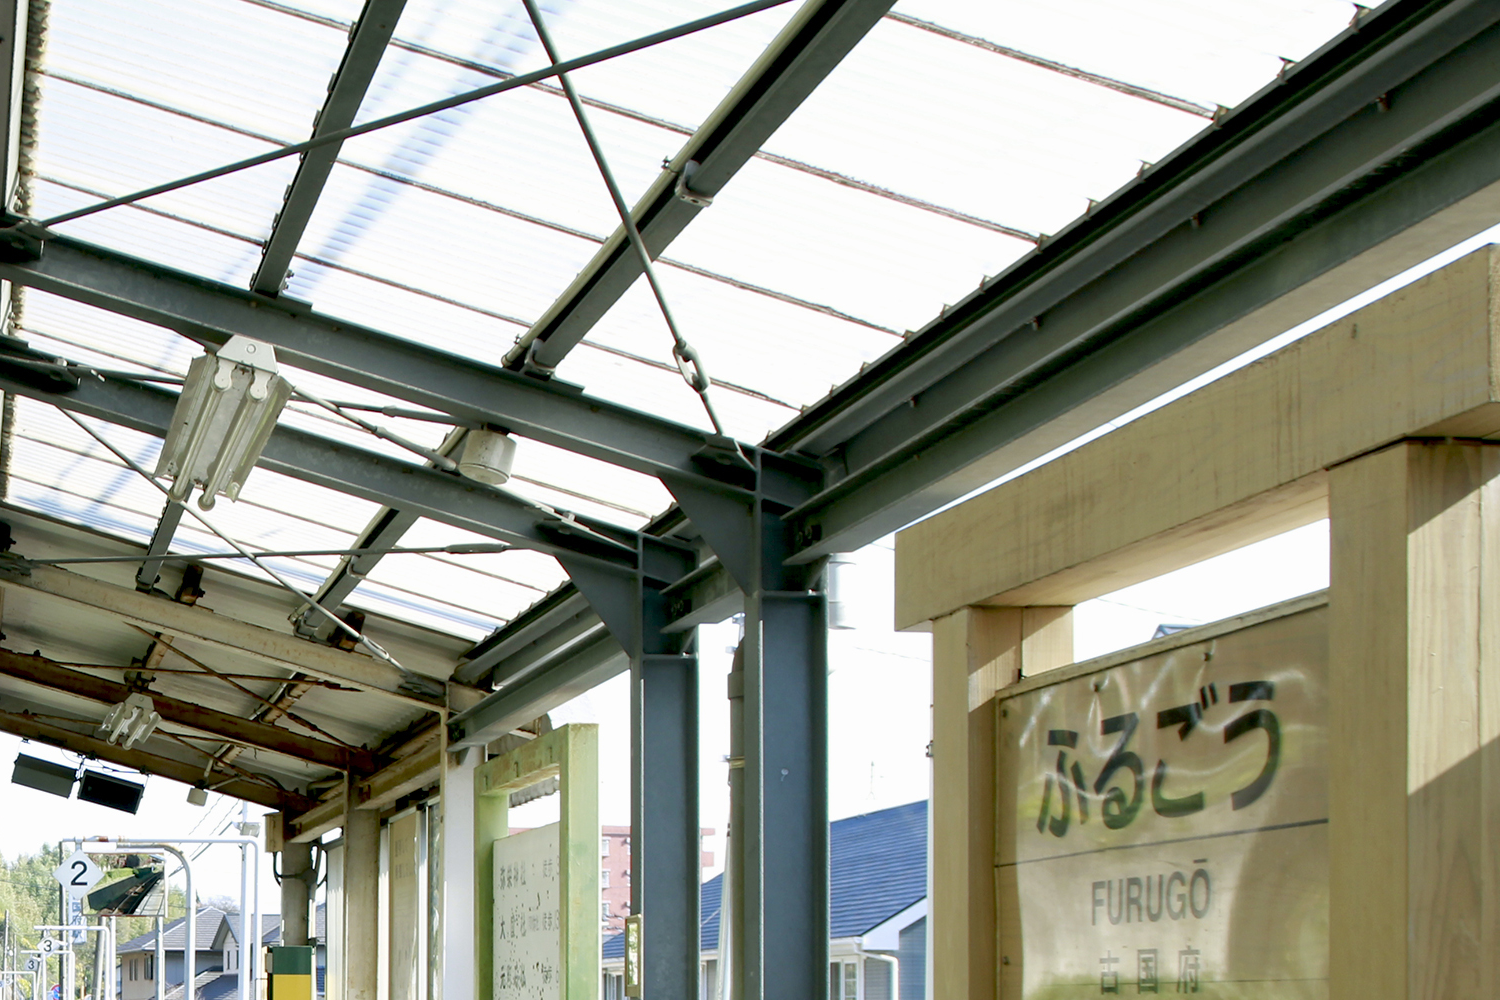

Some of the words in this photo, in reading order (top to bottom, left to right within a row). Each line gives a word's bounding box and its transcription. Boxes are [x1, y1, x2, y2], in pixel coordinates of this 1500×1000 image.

[1036, 679, 1283, 839] ふるごう
[70, 861, 87, 885] 2
[1091, 858, 1212, 926] FURUGŌ
[43, 939, 52, 952] 3
[1099, 945, 1202, 996] 古国府
